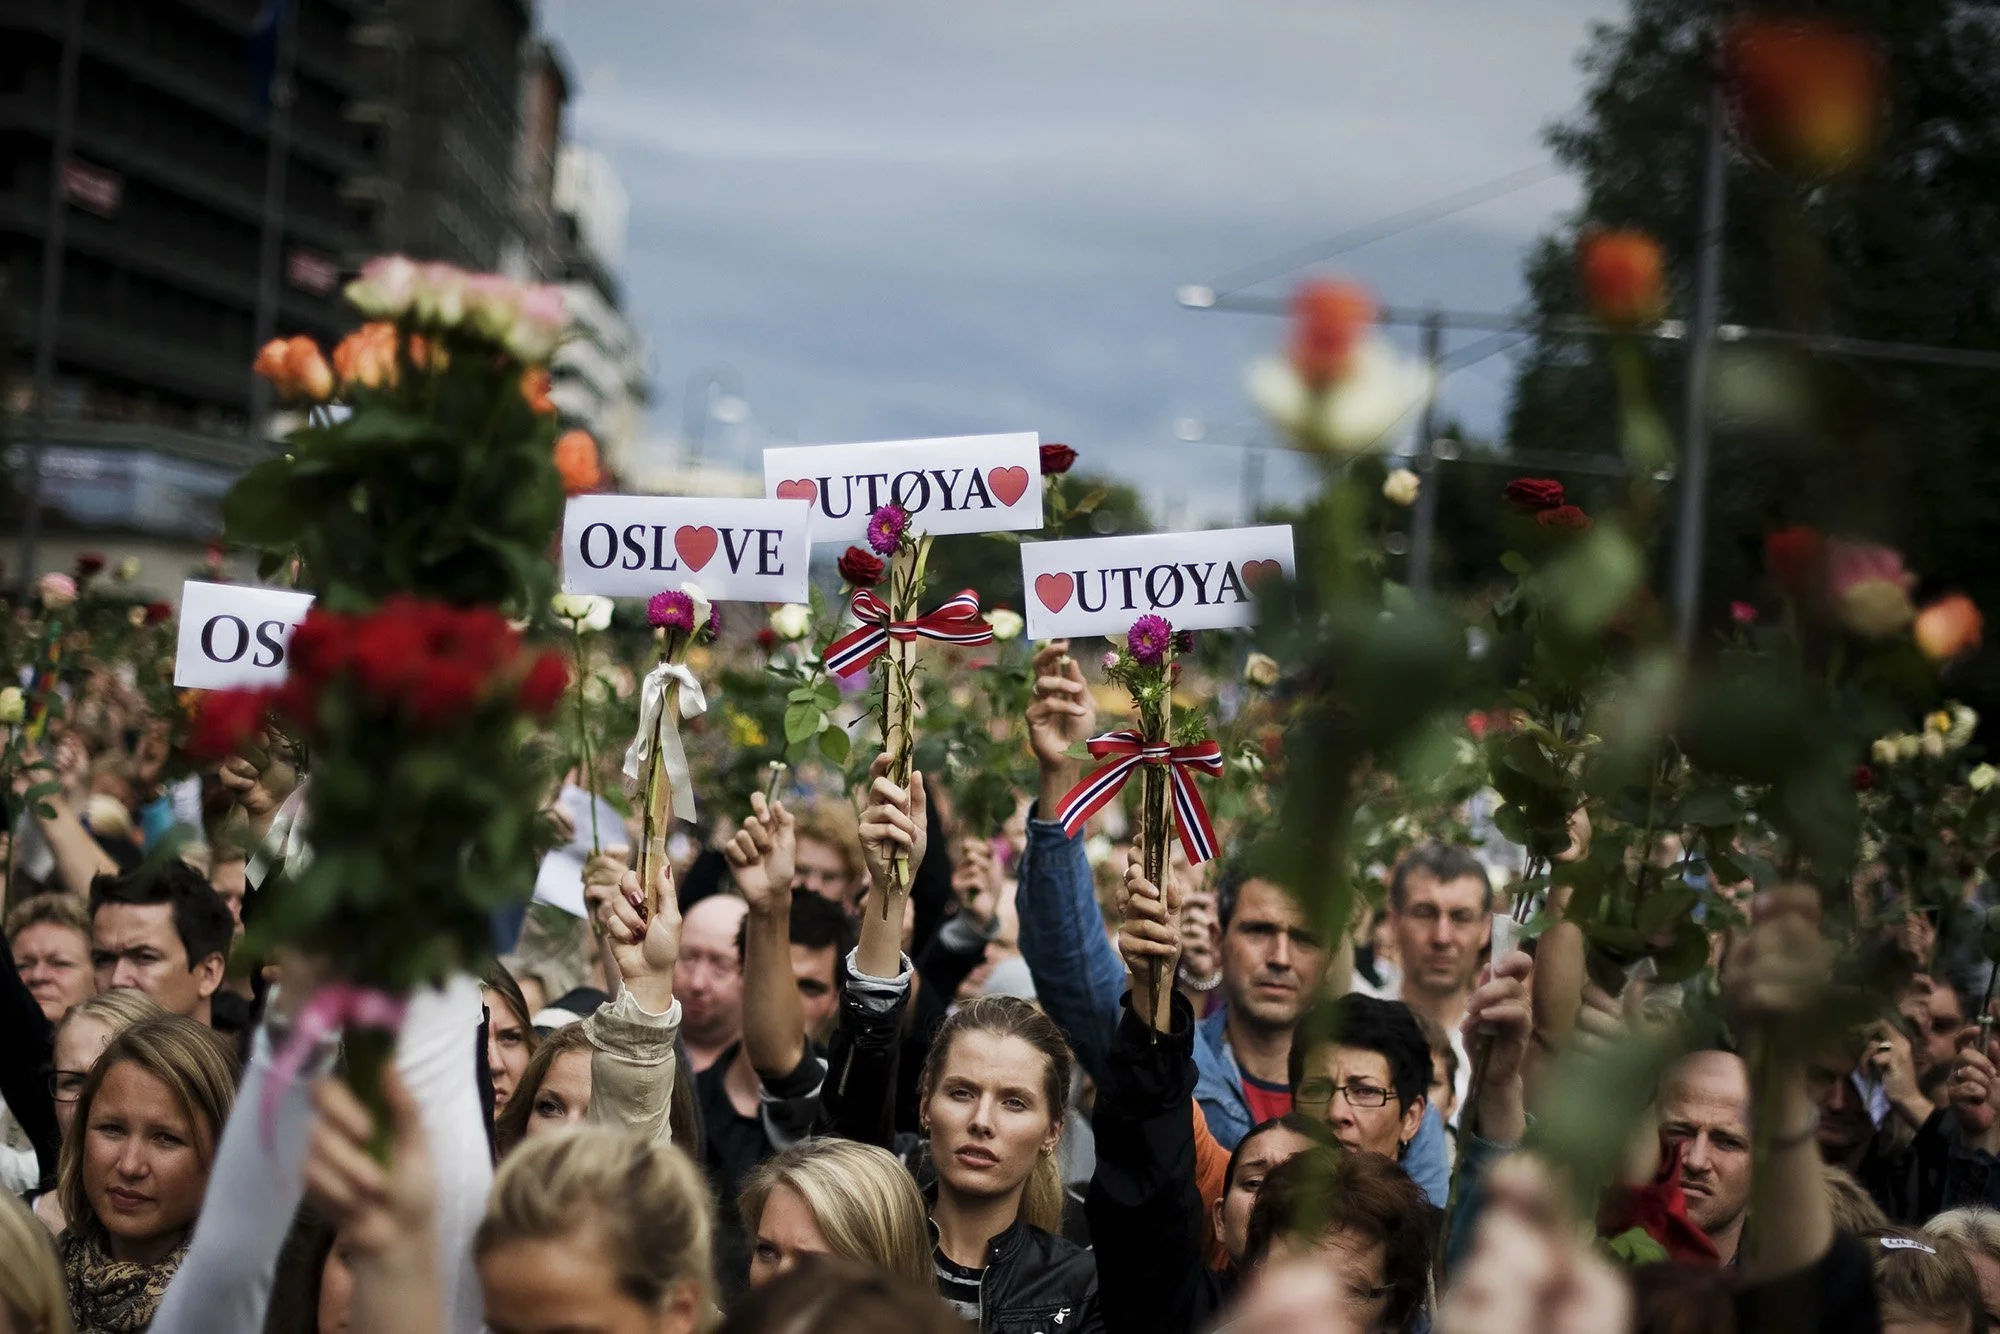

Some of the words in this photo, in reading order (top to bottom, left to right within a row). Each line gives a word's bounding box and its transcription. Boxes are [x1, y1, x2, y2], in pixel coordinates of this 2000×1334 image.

[815, 467, 997, 519] UTØYA
[1071, 560, 1251, 613] UTØYA
[201, 614, 304, 668] OS
